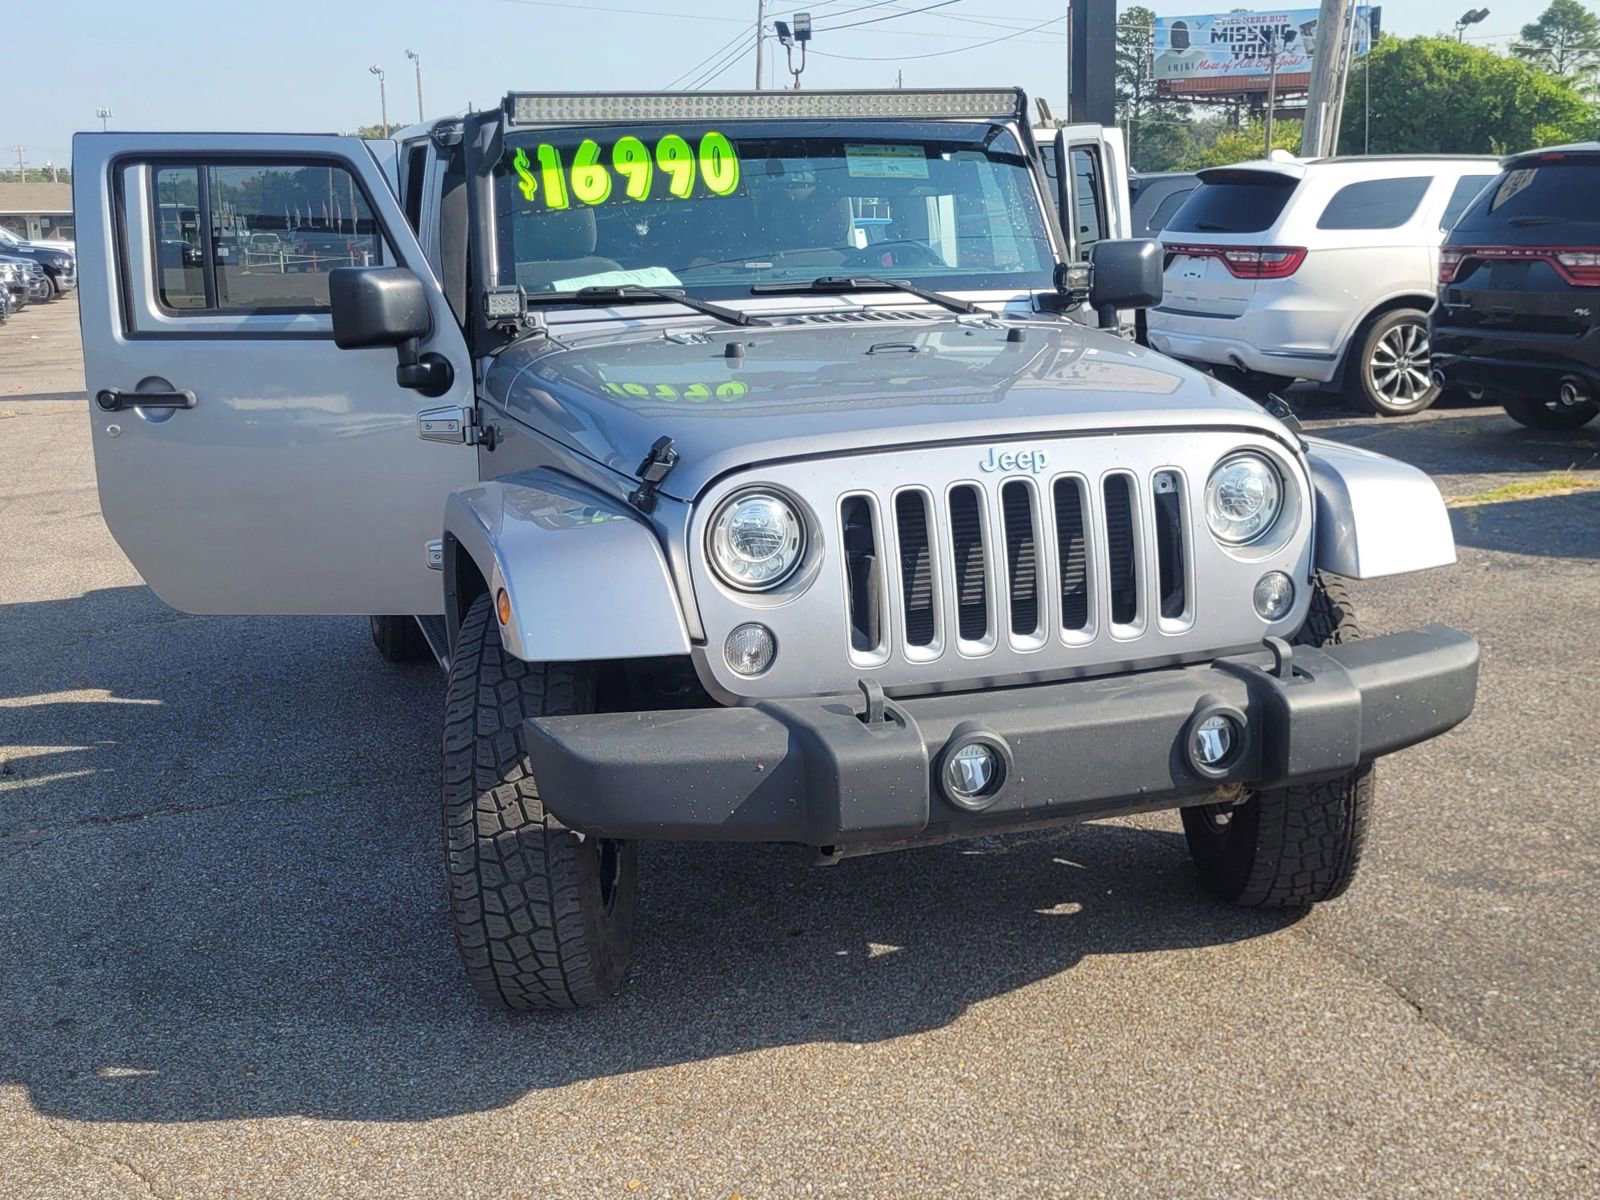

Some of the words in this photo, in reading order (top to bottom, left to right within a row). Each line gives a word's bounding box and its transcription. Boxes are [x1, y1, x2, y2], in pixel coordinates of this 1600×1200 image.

[1231, 43, 1271, 60] YOU
[513, 131, 739, 209] $16990
[979, 447, 1049, 474] Jeep
